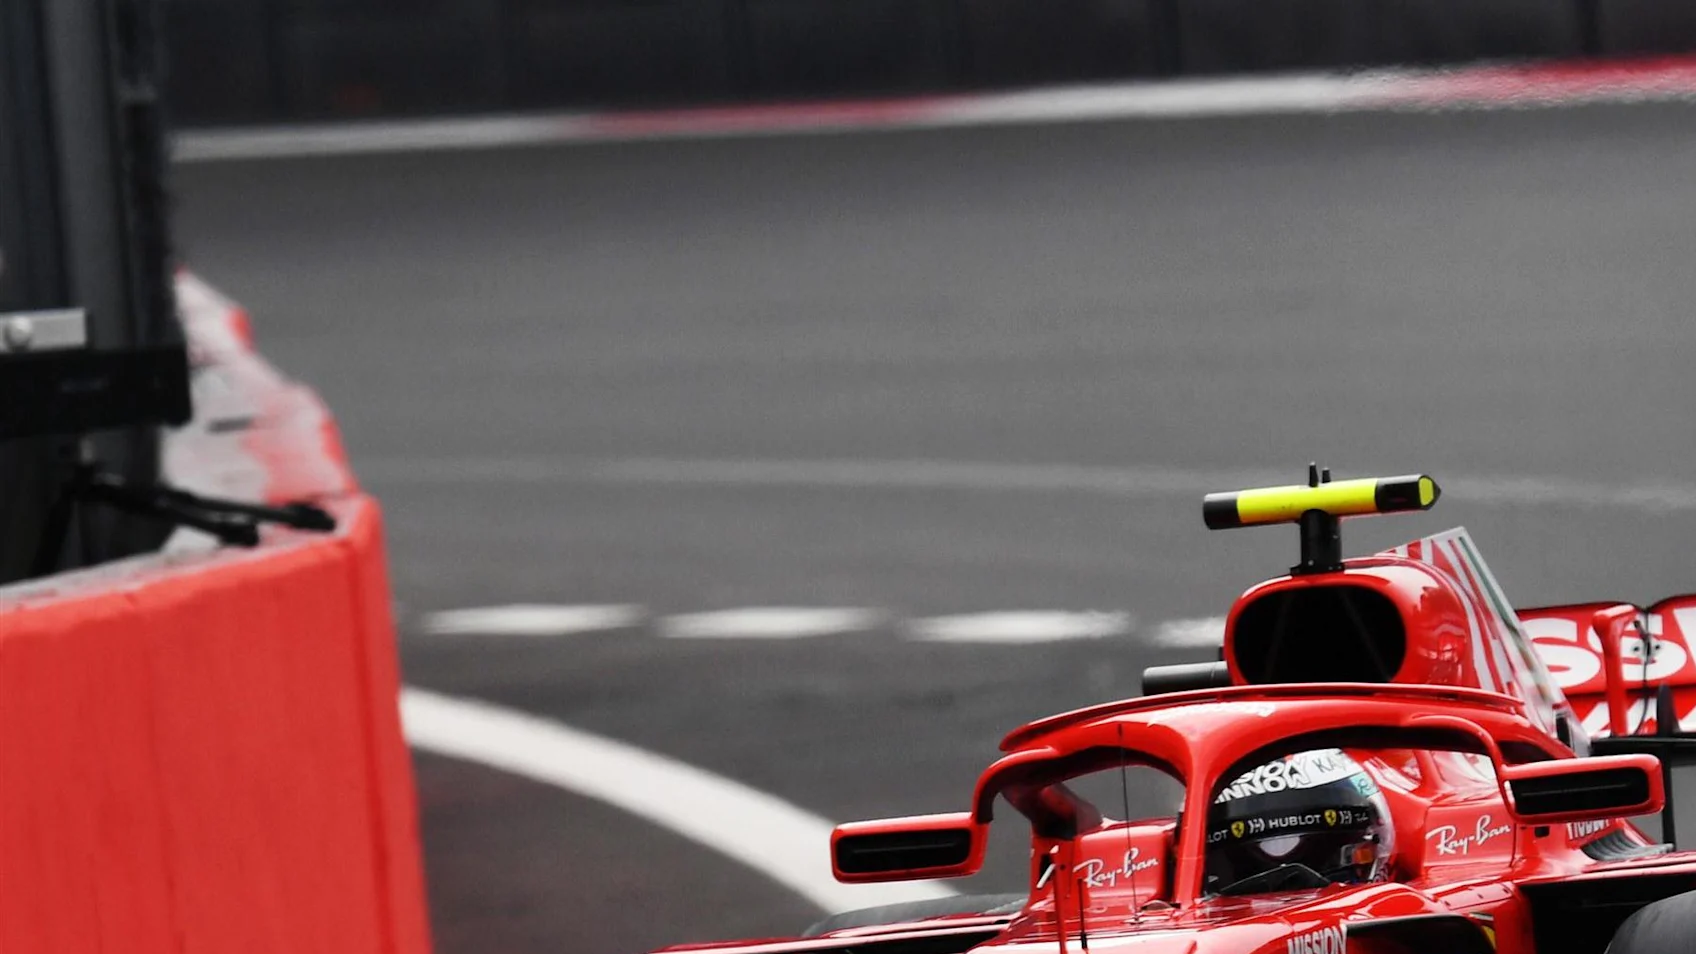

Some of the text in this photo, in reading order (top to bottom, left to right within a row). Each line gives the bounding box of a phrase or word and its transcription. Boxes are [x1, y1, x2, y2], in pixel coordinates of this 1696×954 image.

[1268, 814, 1321, 829] HUBLOT
[1425, 814, 1511, 855] Ray-Ban
[1072, 847, 1159, 888] Ray-Ban
